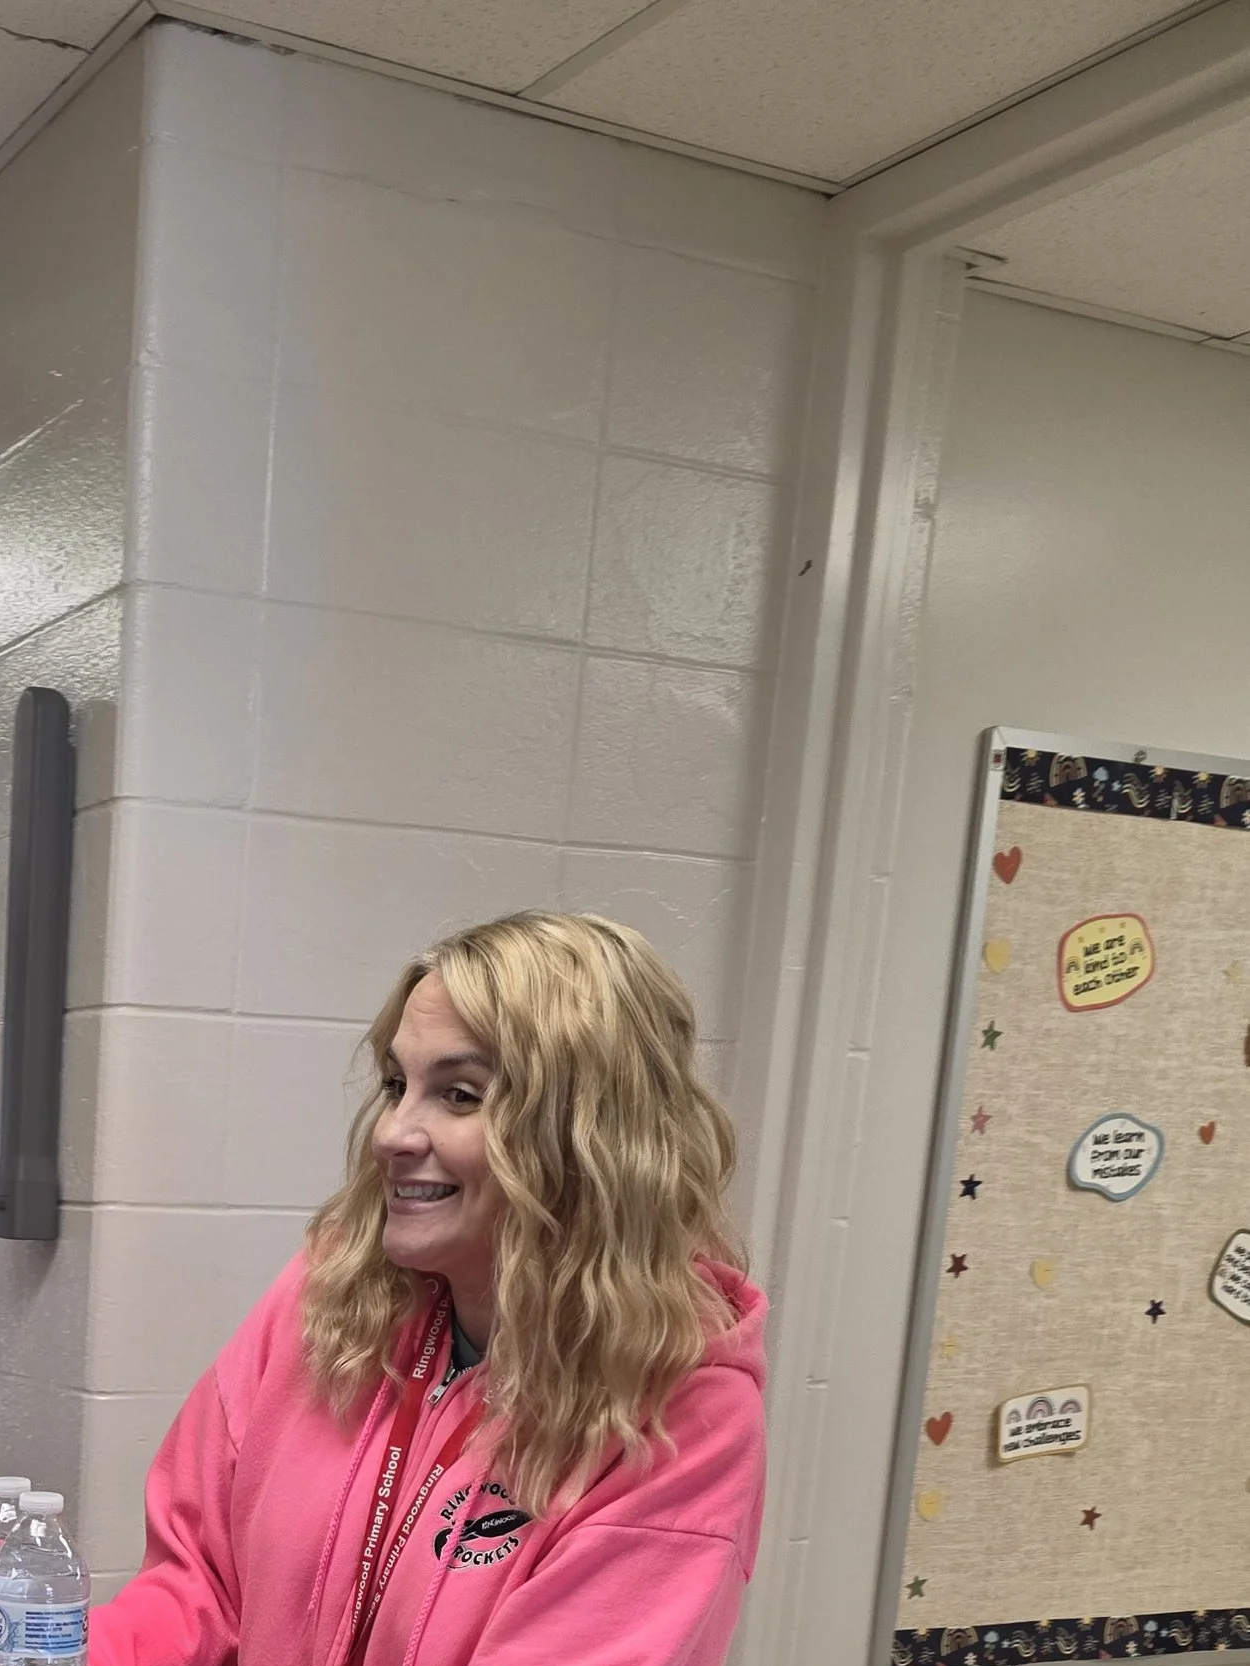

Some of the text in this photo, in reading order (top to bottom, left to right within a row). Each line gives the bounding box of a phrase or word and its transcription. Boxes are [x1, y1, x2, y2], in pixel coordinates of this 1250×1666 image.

[1112, 1129, 1145, 1144] learn
[1091, 1162, 1142, 1179] mistakes
[412, 1311, 446, 1380] Ringwood
[1022, 1430, 1082, 1449] challenges
[365, 1502, 390, 1558] Primary
[378, 1446, 403, 1498] School
[403, 1463, 444, 1535] Ringwood
[379, 1535, 406, 1590] Primary
[453, 1536, 520, 1566] ROCKETS
